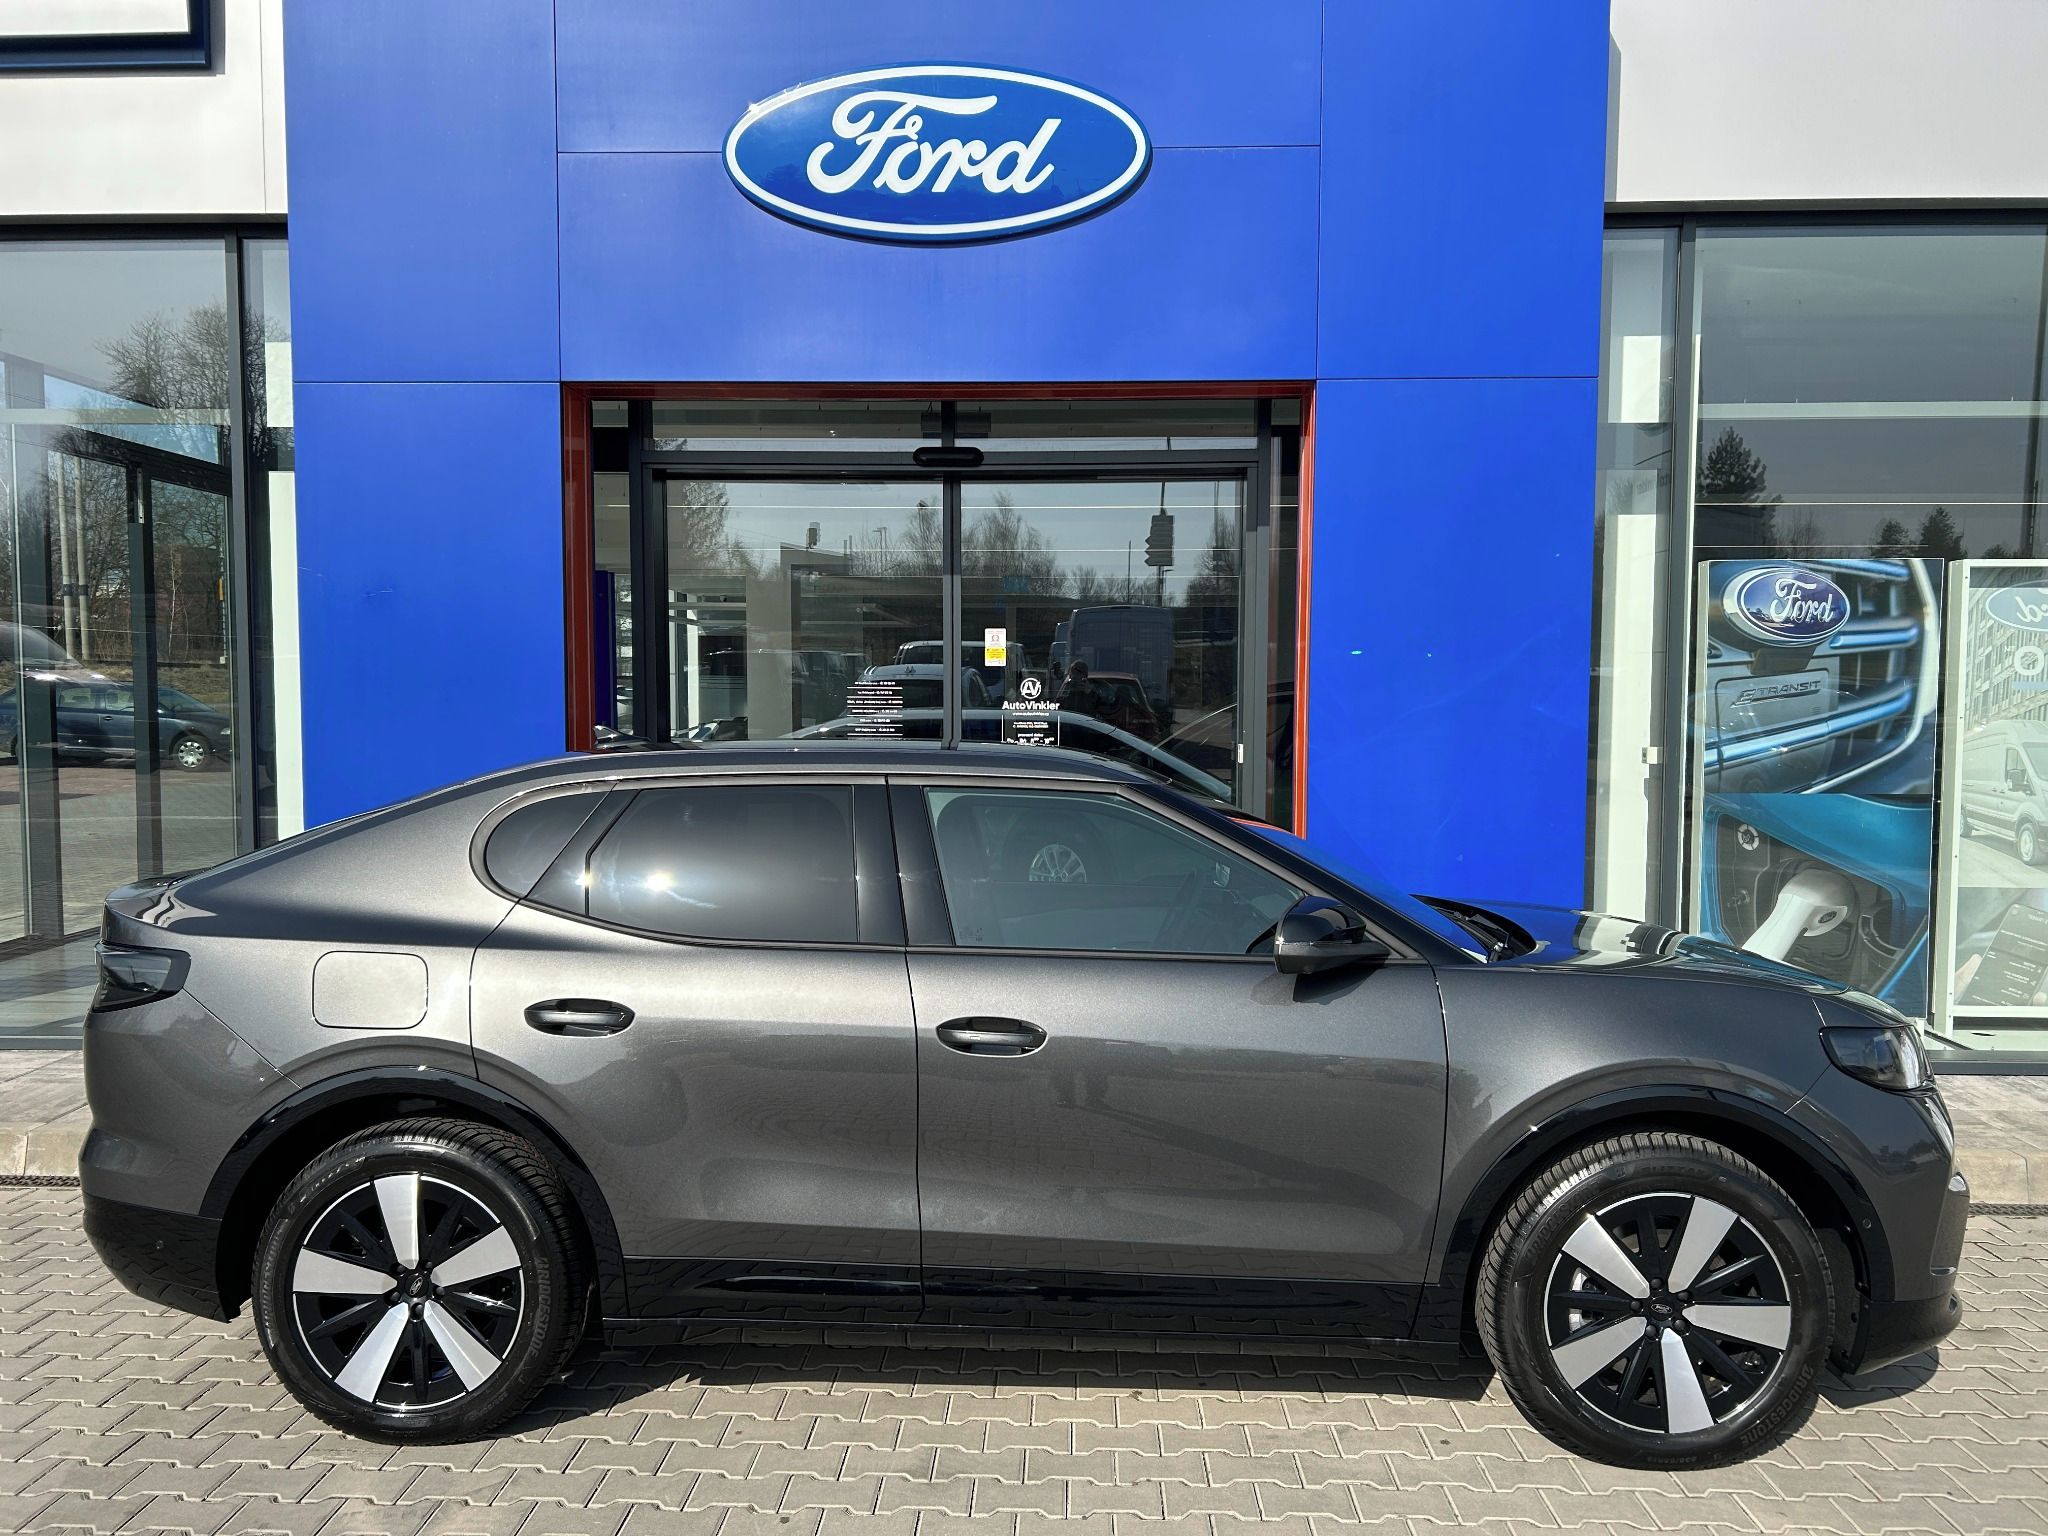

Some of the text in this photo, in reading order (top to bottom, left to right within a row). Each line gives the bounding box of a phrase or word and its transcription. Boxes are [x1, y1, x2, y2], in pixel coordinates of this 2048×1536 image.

[806, 91, 1062, 194] Ford
[1769, 578, 1834, 623] Ford
[1001, 700, 1061, 710] AutoVinkler
[1739, 1363, 1815, 1447] BRIDGESTONE
